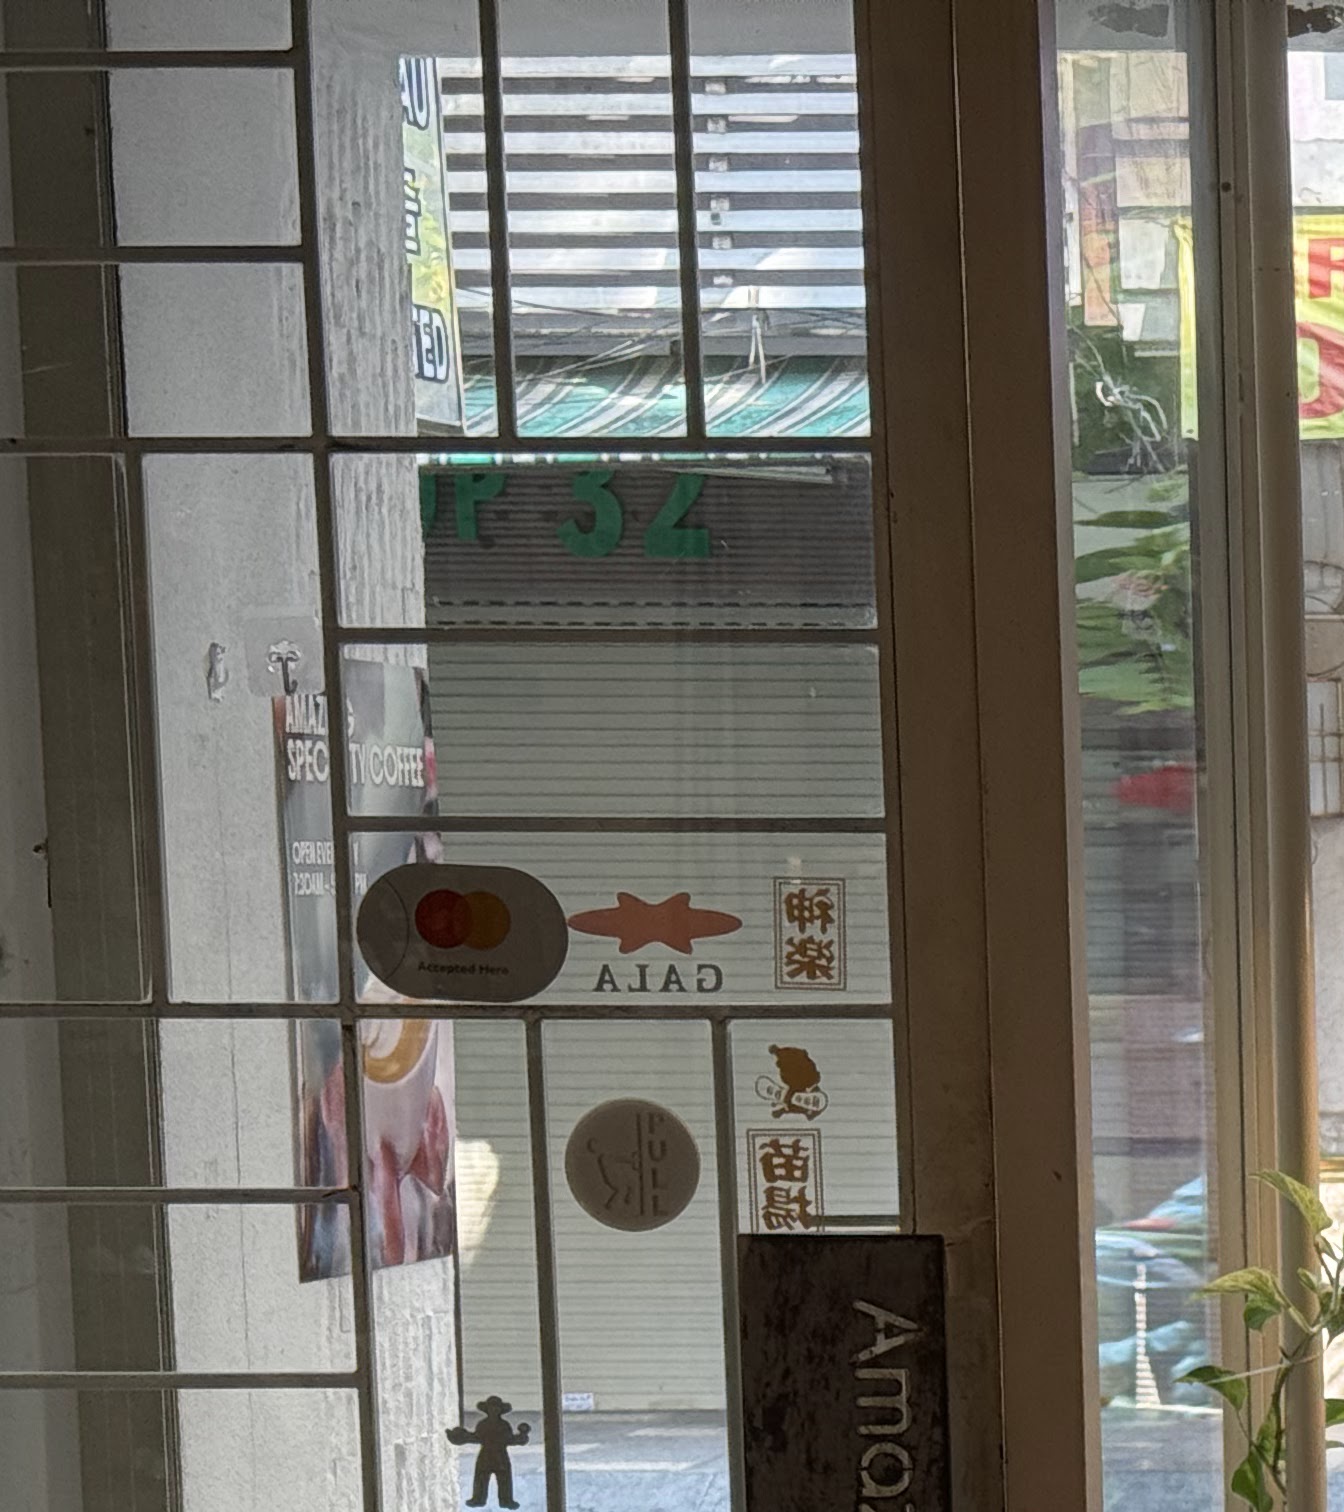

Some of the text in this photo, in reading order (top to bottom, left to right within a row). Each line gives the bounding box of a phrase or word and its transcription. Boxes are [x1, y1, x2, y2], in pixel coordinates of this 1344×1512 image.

[369, 745, 425, 788] COFFEE
[292, 841, 315, 864] OPEN
[417, 960, 477, 976] Accepted
[646, 1113, 668, 1218] PULL
